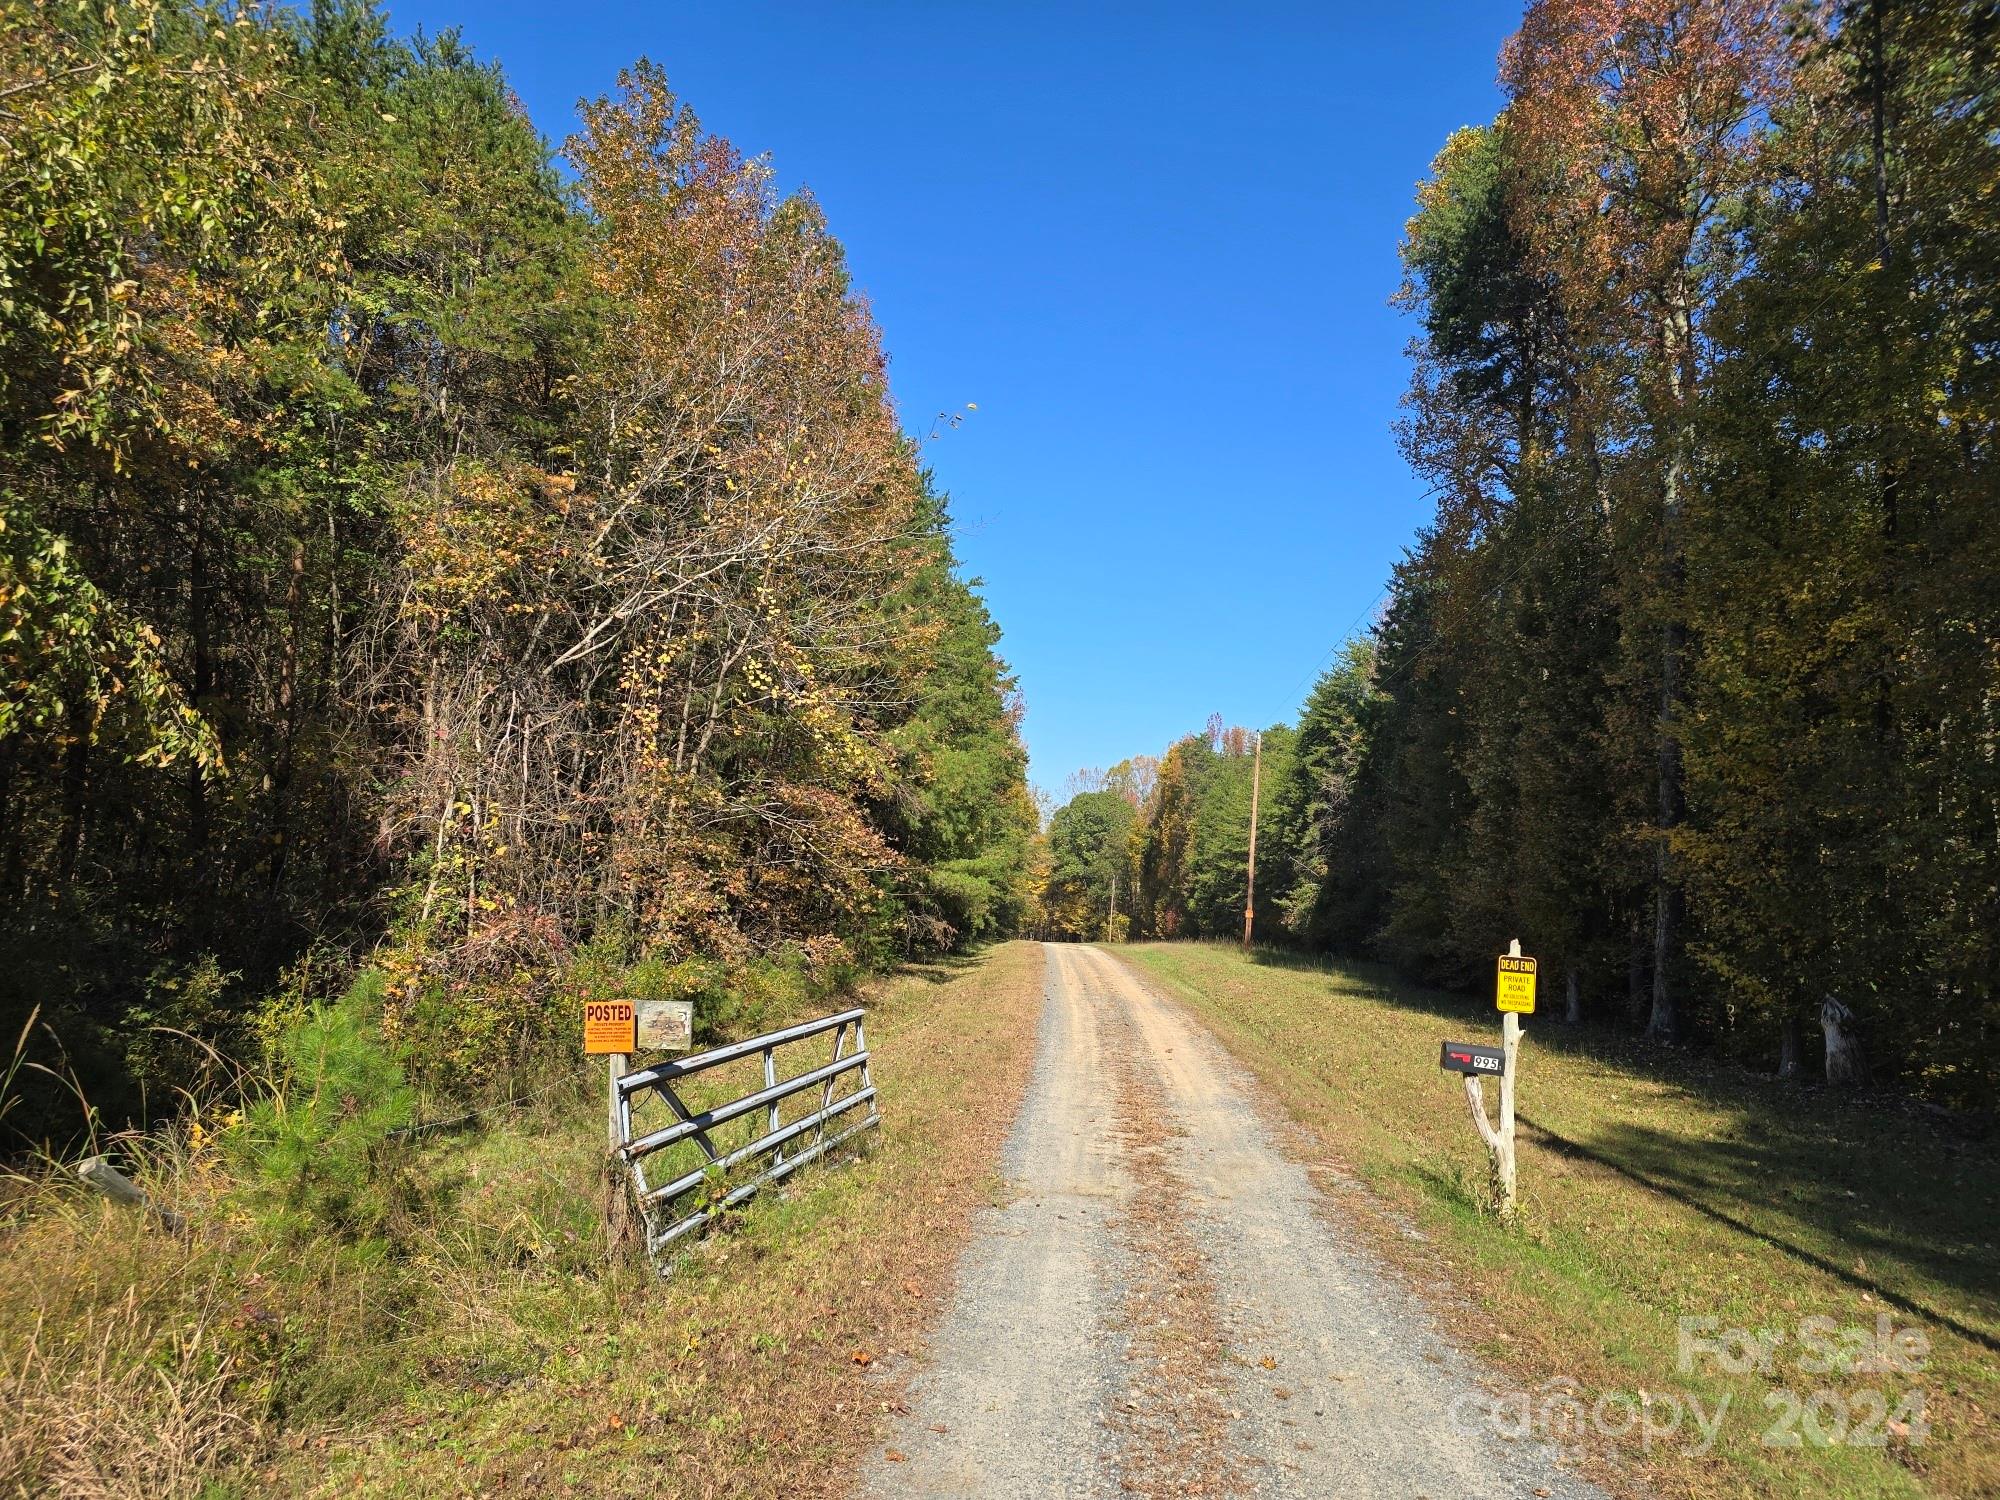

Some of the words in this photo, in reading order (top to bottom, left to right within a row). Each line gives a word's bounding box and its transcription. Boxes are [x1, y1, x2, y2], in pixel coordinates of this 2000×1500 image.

[1501, 959, 1519, 970] DEAD
[1520, 961, 1534, 971] END
[1503, 976, 1531, 984] PRIVATE
[1509, 984, 1525, 992] ROAD
[587, 1005, 631, 1021] POSTED
[1475, 1057, 1497, 1069] 995
